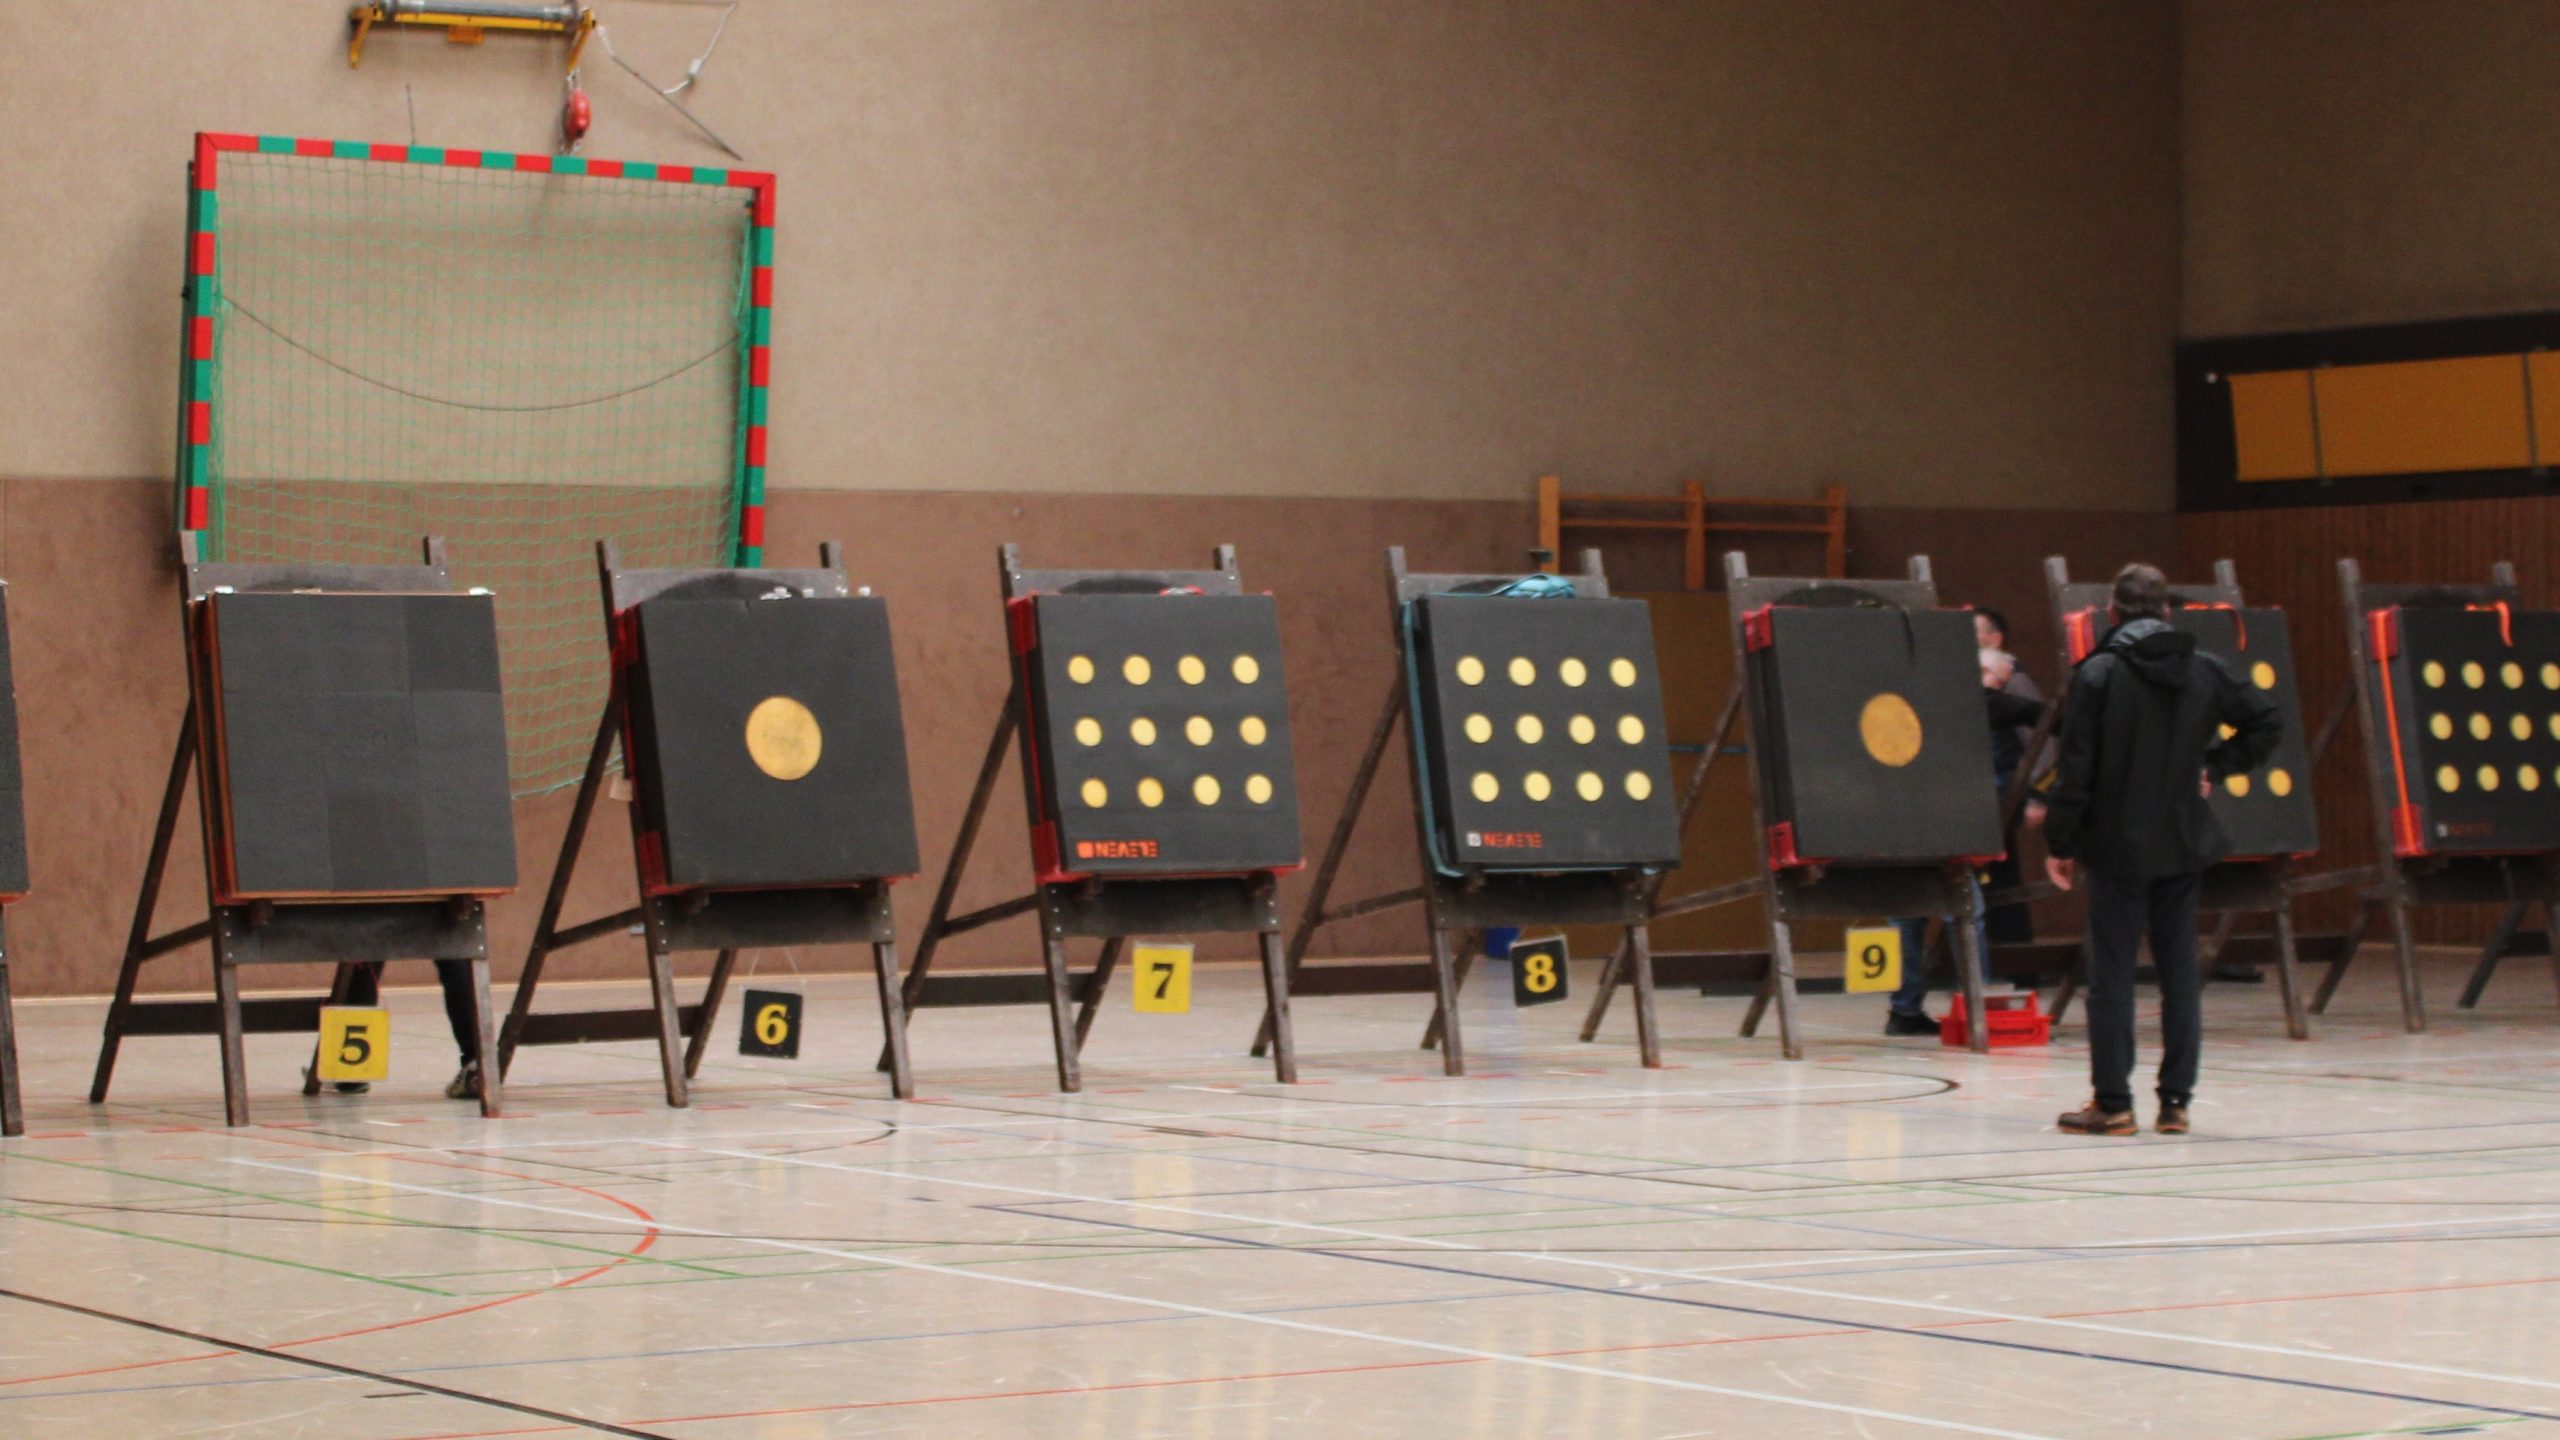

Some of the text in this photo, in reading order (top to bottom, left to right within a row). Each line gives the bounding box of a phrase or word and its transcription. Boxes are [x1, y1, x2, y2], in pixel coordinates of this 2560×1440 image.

[1095, 841, 1158, 858] ELEVEN
[1524, 954, 1557, 993] 8
[1862, 945, 1887, 979] 9
[1151, 963, 1175, 999] 7
[755, 1003, 788, 1046] 6
[339, 1025, 371, 1066] 5
